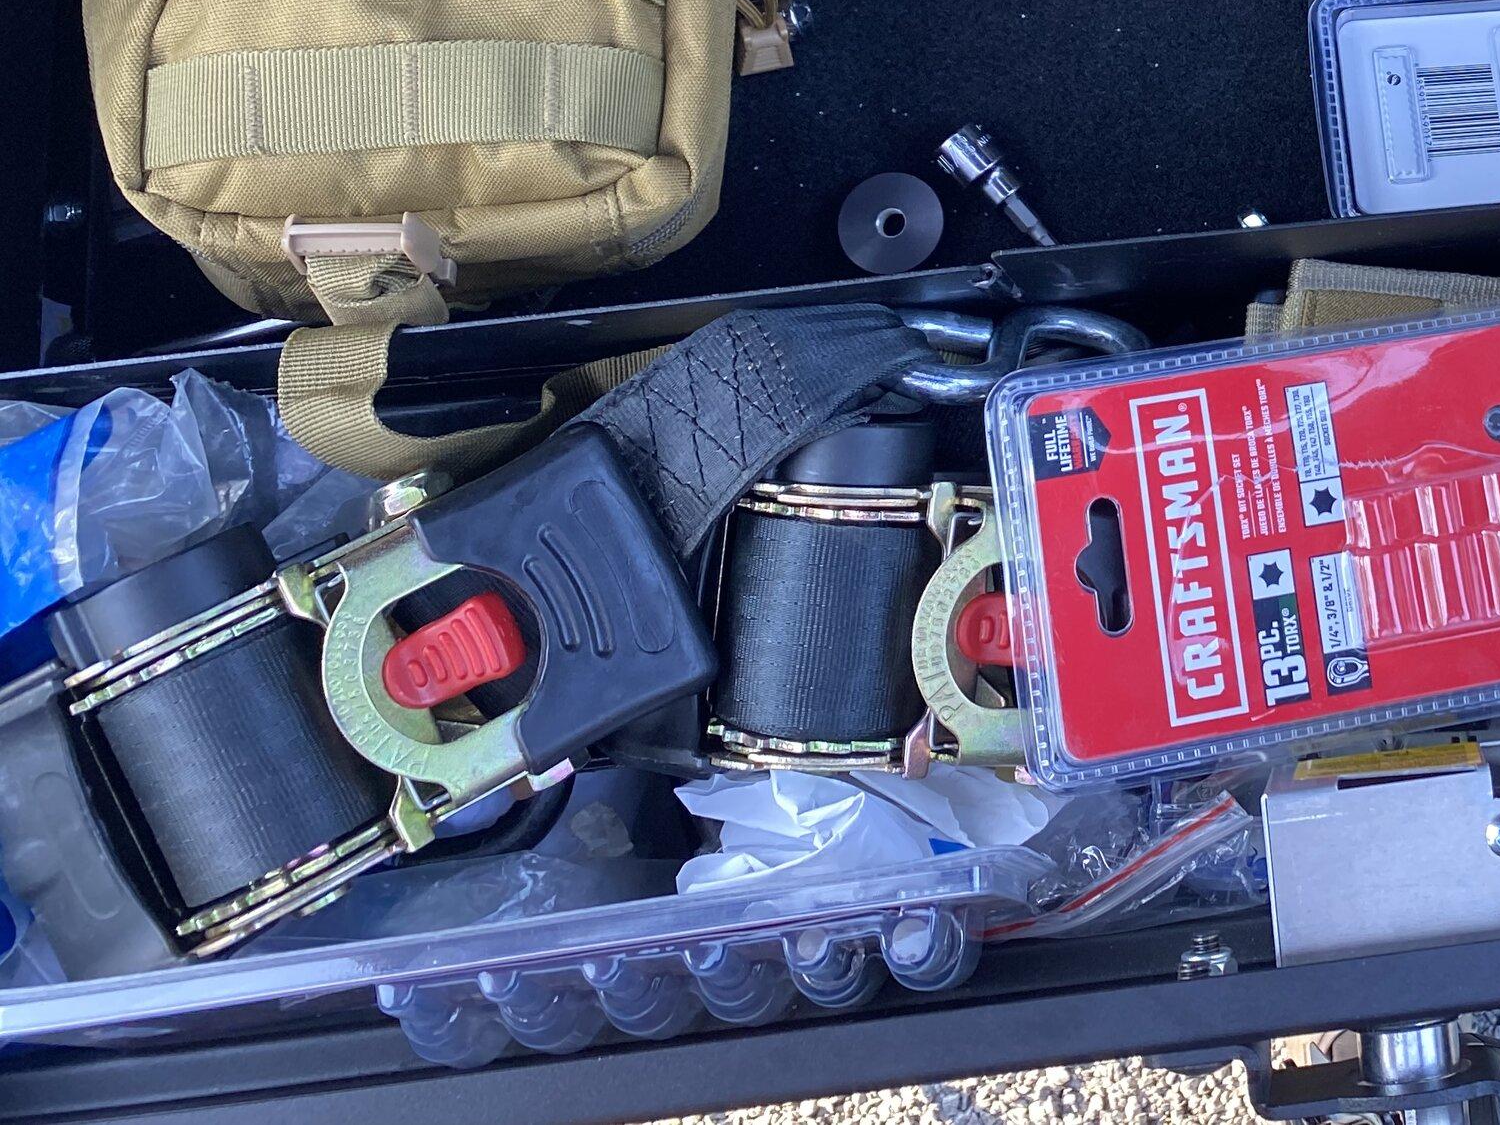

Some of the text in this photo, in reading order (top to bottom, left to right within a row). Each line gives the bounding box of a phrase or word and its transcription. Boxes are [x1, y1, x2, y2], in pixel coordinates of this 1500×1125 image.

[1042, 428, 1060, 462] FULL
[1052, 413, 1075, 473] LIFETIME
[1231, 452, 1241, 468] SET
[1256, 619, 1310, 708] 13 PC.
